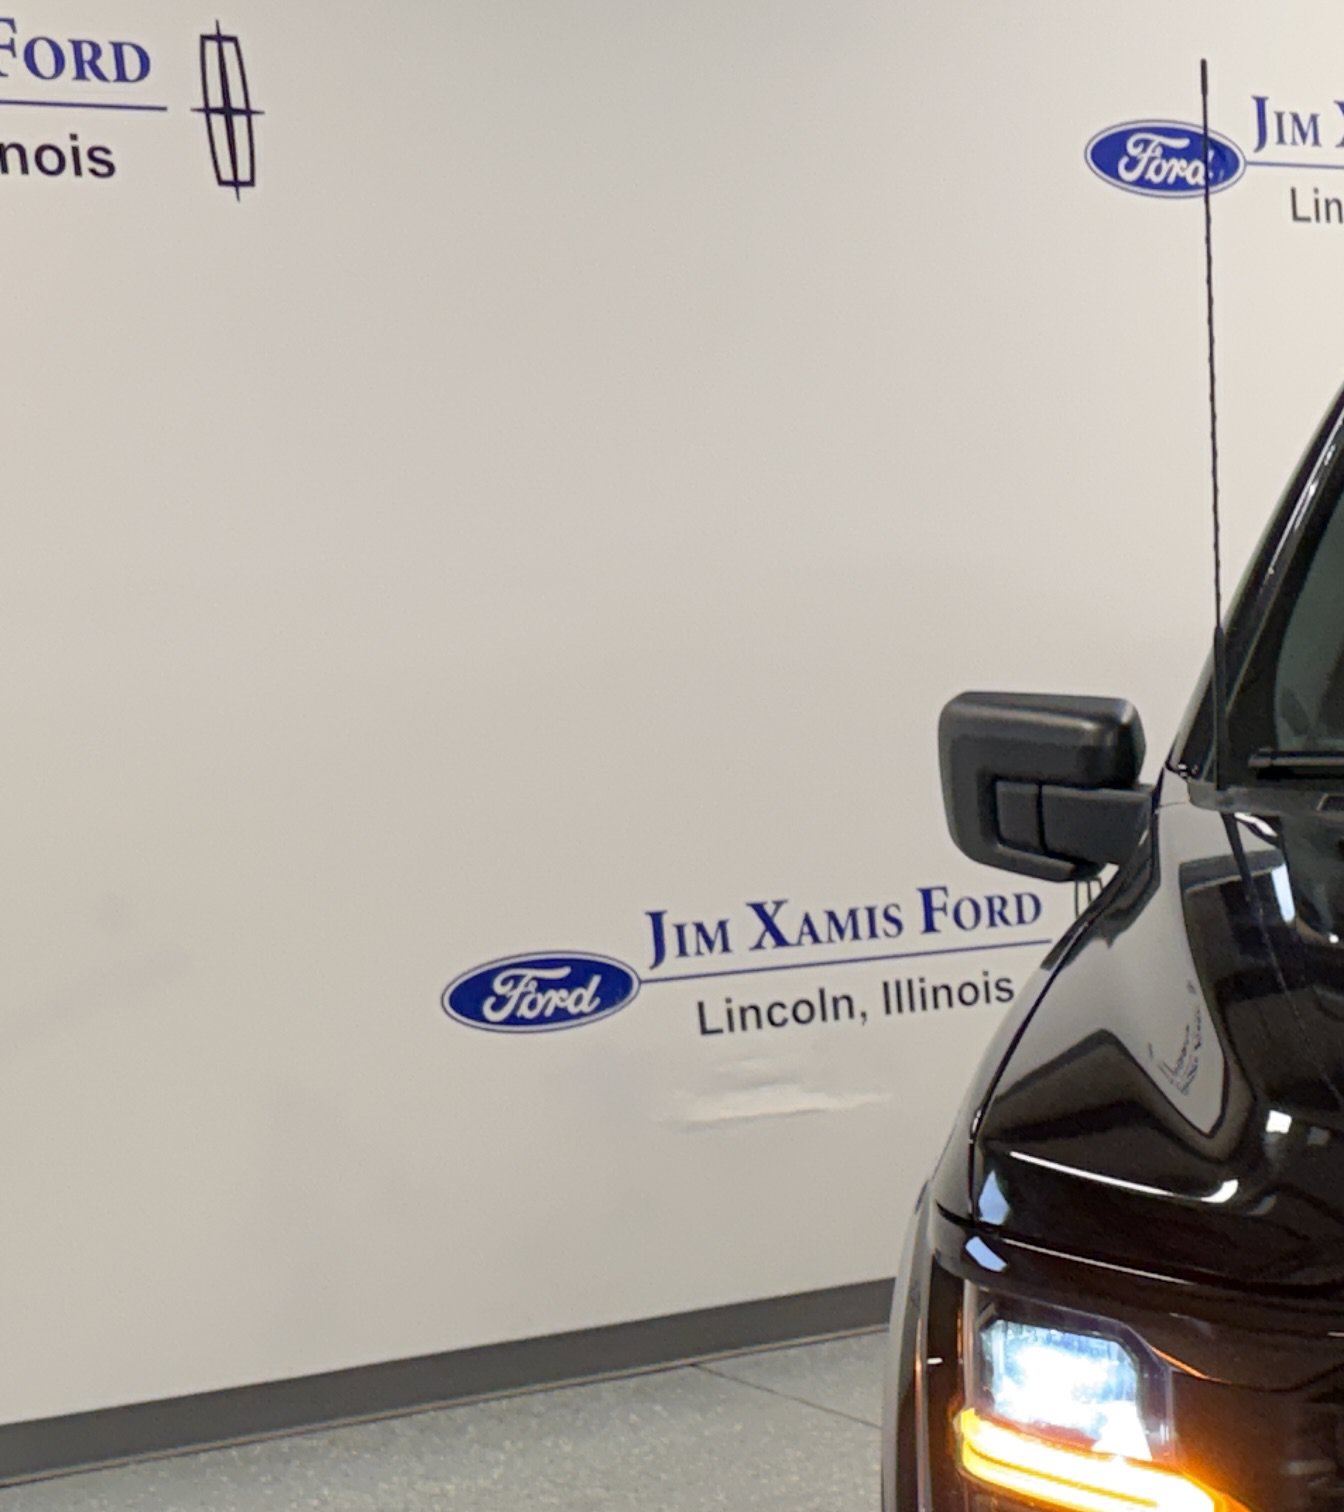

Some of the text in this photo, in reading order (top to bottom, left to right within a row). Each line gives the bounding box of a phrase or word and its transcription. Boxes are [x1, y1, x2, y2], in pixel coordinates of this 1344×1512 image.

[1252, 95, 1321, 153] JIM
[1118, 132, 1214, 185] Ford
[645, 885, 1042, 970] JIM XAMIS FORD
[482, 966, 601, 1020] Ford
[698, 970, 1015, 1036] Lincoln, Illinois
